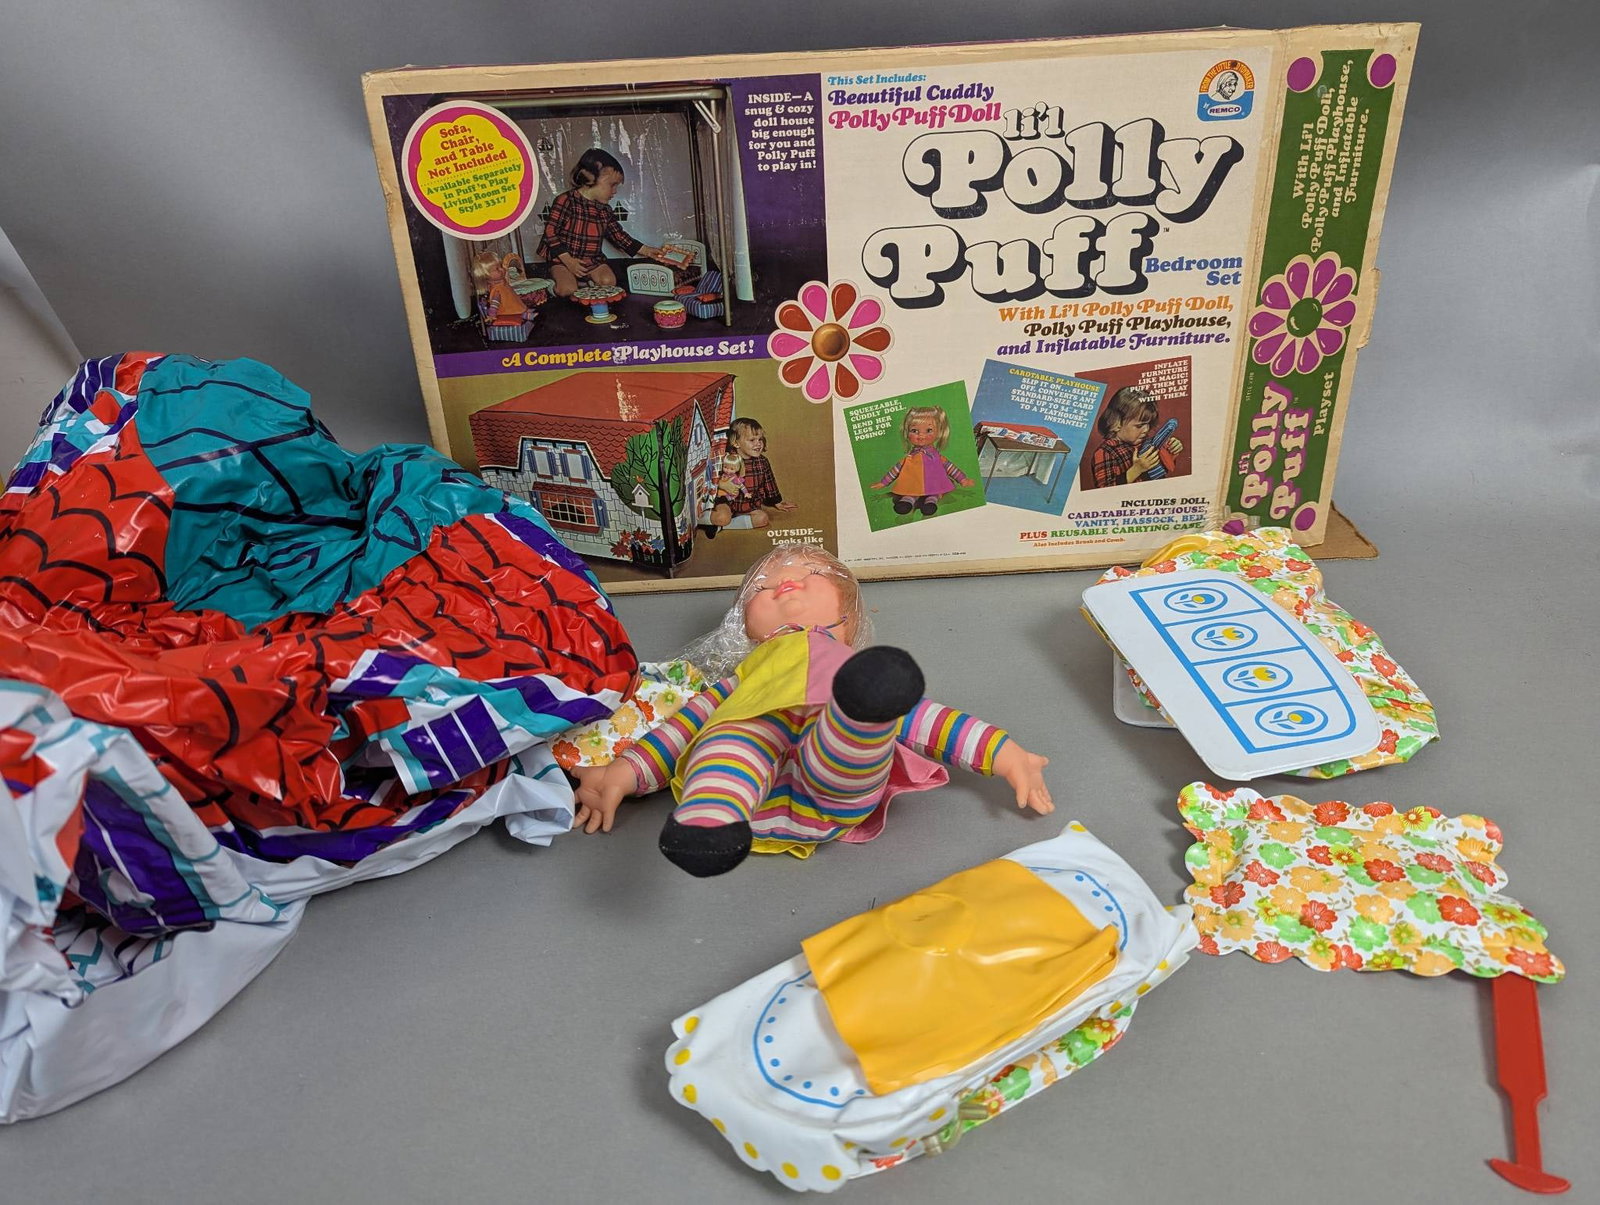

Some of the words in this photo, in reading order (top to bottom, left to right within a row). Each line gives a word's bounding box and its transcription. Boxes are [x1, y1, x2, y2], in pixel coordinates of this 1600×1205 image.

[828, 75, 854, 86] This
[856, 75, 874, 84] Set
[876, 73, 927, 84] Includes:
[804, 92, 813, 100] A
[828, 86, 922, 106] Beautiful
[927, 83, 994, 101] Cuddly
[745, 107, 772, 116] snug
[775, 105, 785, 113] &
[787, 105, 814, 114] cozy
[828, 109, 891, 132] Polly
[892, 105, 947, 129] Puff
[949, 102, 1001, 123] Doll
[1317, 87, 1335, 135] Doll,
[1326, 60, 1353, 161] Playhouse,
[754, 117, 778, 127] doll
[781, 117, 815, 125] house
[440, 125, 472, 138] Sofa,
[752, 129, 770, 139] big
[772, 127, 815, 138] enough
[1335, 96, 1359, 182] Inflatable
[440, 136, 479, 150] Chair,
[748, 141, 766, 150] for
[770, 141, 791, 150] you
[794, 138, 815, 147] and
[434, 151, 457, 165] and
[460, 142, 494, 158] Table
[758, 151, 787, 160] Polly
[790, 149, 816, 158] Puff
[1310, 137, 1328, 180] Puff
[1345, 109, 1369, 204] Furniture.
[428, 167, 451, 179] Not
[454, 150, 507, 172] Included
[758, 163, 769, 171] to
[772, 161, 798, 172] play
[800, 160, 816, 169] in!
[902, 118, 1244, 223] Polly
[427, 177, 470, 195] Available
[473, 163, 521, 181] Separately
[1293, 155, 1309, 198] With
[1319, 162, 1337, 204] Puff
[443, 196, 473, 209] Living
[475, 186, 500, 200] Room
[501, 184, 516, 192] Set
[444, 191, 454, 200] in
[456, 185, 476, 196] Puff
[490, 177, 508, 188] Play
[459, 203, 482, 214] Style
[485, 196, 507, 208] 3317
[1302, 183, 1320, 229] Polly
[1332, 187, 1343, 217] and
[1310, 205, 1329, 253] Polly
[862, 212, 1160, 309] Puff
[1145, 256, 1243, 273] Bedroom
[1206, 271, 1242, 286] Set
[999, 306, 1045, 322] With
[1082, 300, 1134, 317] Polly
[1137, 297, 1183, 315] Puff
[1185, 295, 1234, 312] Doll,
[1024, 322, 1075, 338] Polly
[1079, 318, 1123, 335] Puff
[1126, 314, 1231, 332] Playhouse,
[997, 340, 1031, 355] and
[1037, 336, 1131, 355] Inflatable
[1129, 331, 1230, 350] Furniture.
[502, 352, 521, 368] A
[525, 348, 612, 367] Complete
[613, 341, 714, 363] Playhouse
[718, 340, 755, 356] Set!
[1141, 366, 1188, 378] FURNITURE
[1155, 360, 1188, 370] INFLATE
[1009, 369, 1055, 383] CARDTABLE
[1056, 378, 1100, 392] PLAYHOUSE
[1022, 378, 1037, 386] SLIP
[1072, 388, 1089, 396] SLIP
[1130, 384, 1150, 392] PUFF
[1153, 380, 1175, 388] THEM
[1139, 377, 1156, 385] LIKE
[1159, 373, 1188, 382] MAGIC!
[1021, 384, 1036, 392] OFF.
[1038, 388, 1078, 400] CONVERTS
[1138, 395, 1161, 403] WITH
[1164, 391, 1188, 399] THEM.
[1169, 385, 1188, 393] PLAY
[849, 400, 901, 417] SQUEEZABLE,
[1011, 389, 1071, 406] STANDARD-SIZE
[1072, 402, 1094, 410] CARD
[1011, 395, 1034, 404] TABLE
[1313, 372, 1334, 436] Playset
[850, 410, 881, 422] CUDDLY
[884, 405, 907, 414] DOLL.
[1044, 415, 1087, 428] INSTANTLY!
[852, 420, 873, 430] BEND
[854, 427, 874, 436] LEGS
[876, 422, 891, 430] FOR
[855, 430, 886, 441] POSING!
[1240, 381, 1292, 509] Polly
[1270, 408, 1313, 520] Puff
[1121, 498, 1176, 508] INCLUDES
[1180, 497, 1210, 507] DOLL,
[1020, 531, 1047, 540] PLUS
[1051, 527, 1108, 537] REUSABLE
[1112, 524, 1169, 534] CARRYING
[1173, 522, 1205, 530] CASE.
[1075, 519, 1119, 528] VANITY,
[1122, 516, 1178, 526] HASSOCK,
